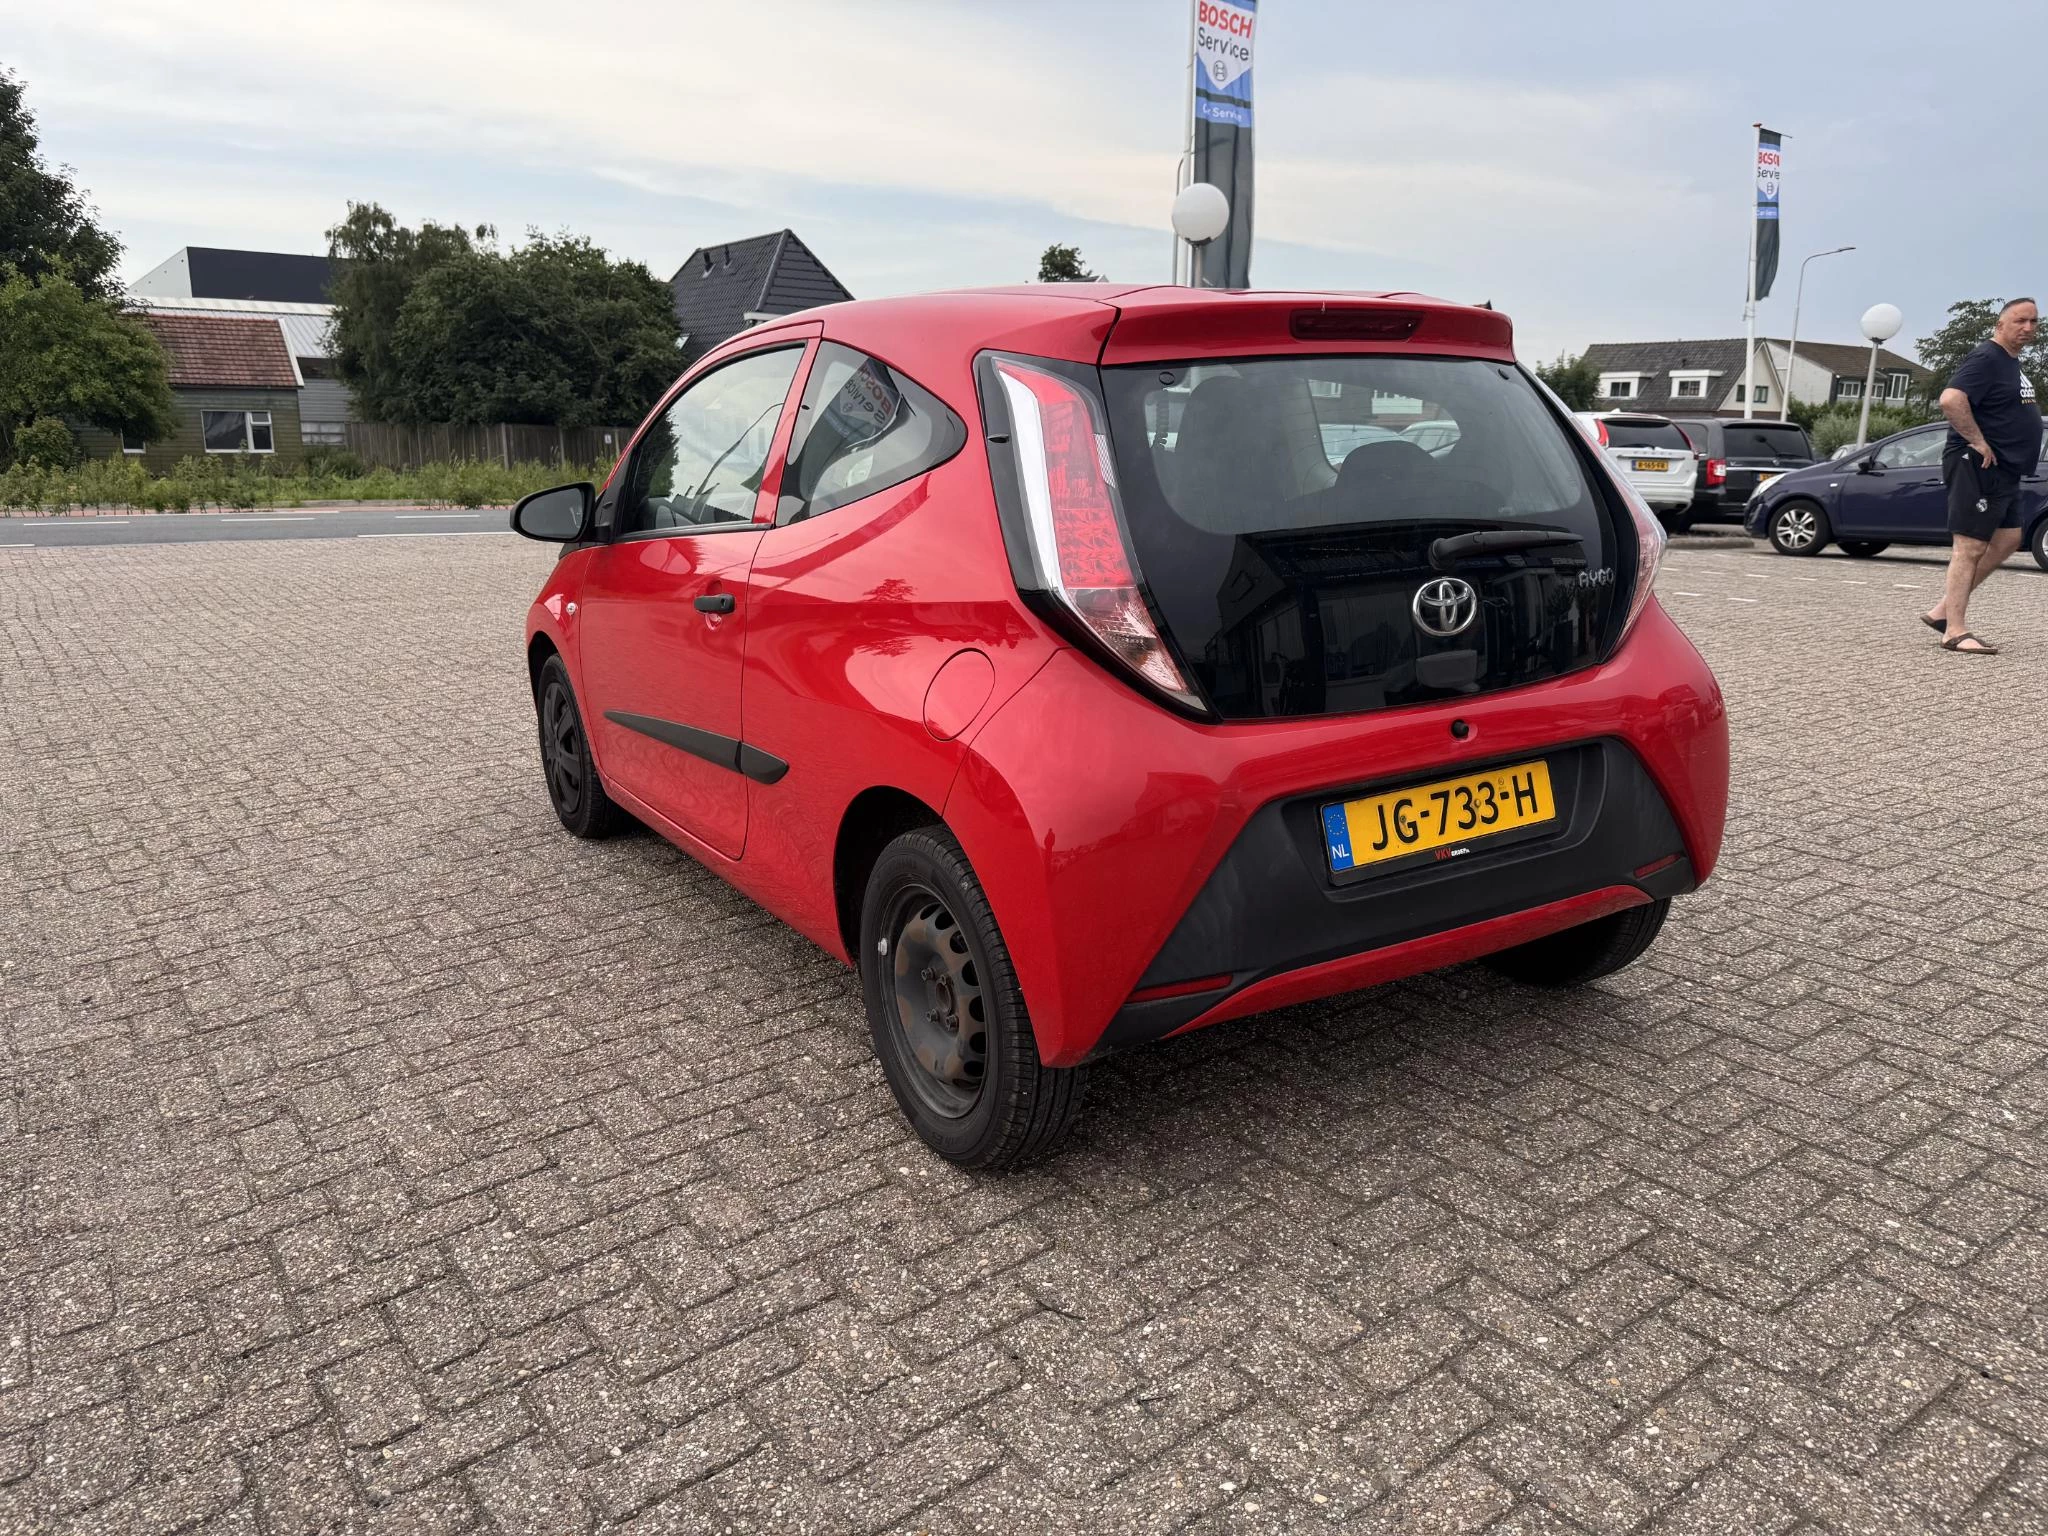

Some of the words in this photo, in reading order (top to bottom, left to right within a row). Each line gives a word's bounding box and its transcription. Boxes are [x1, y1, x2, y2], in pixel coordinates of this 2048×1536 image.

[1198, 1, 1253, 39] BOSCH
[1197, 26, 1250, 61] Service
[1578, 567, 1614, 588] AYGO
[1372, 772, 1539, 851] JG-733-H
[1331, 843, 1350, 860] NL
